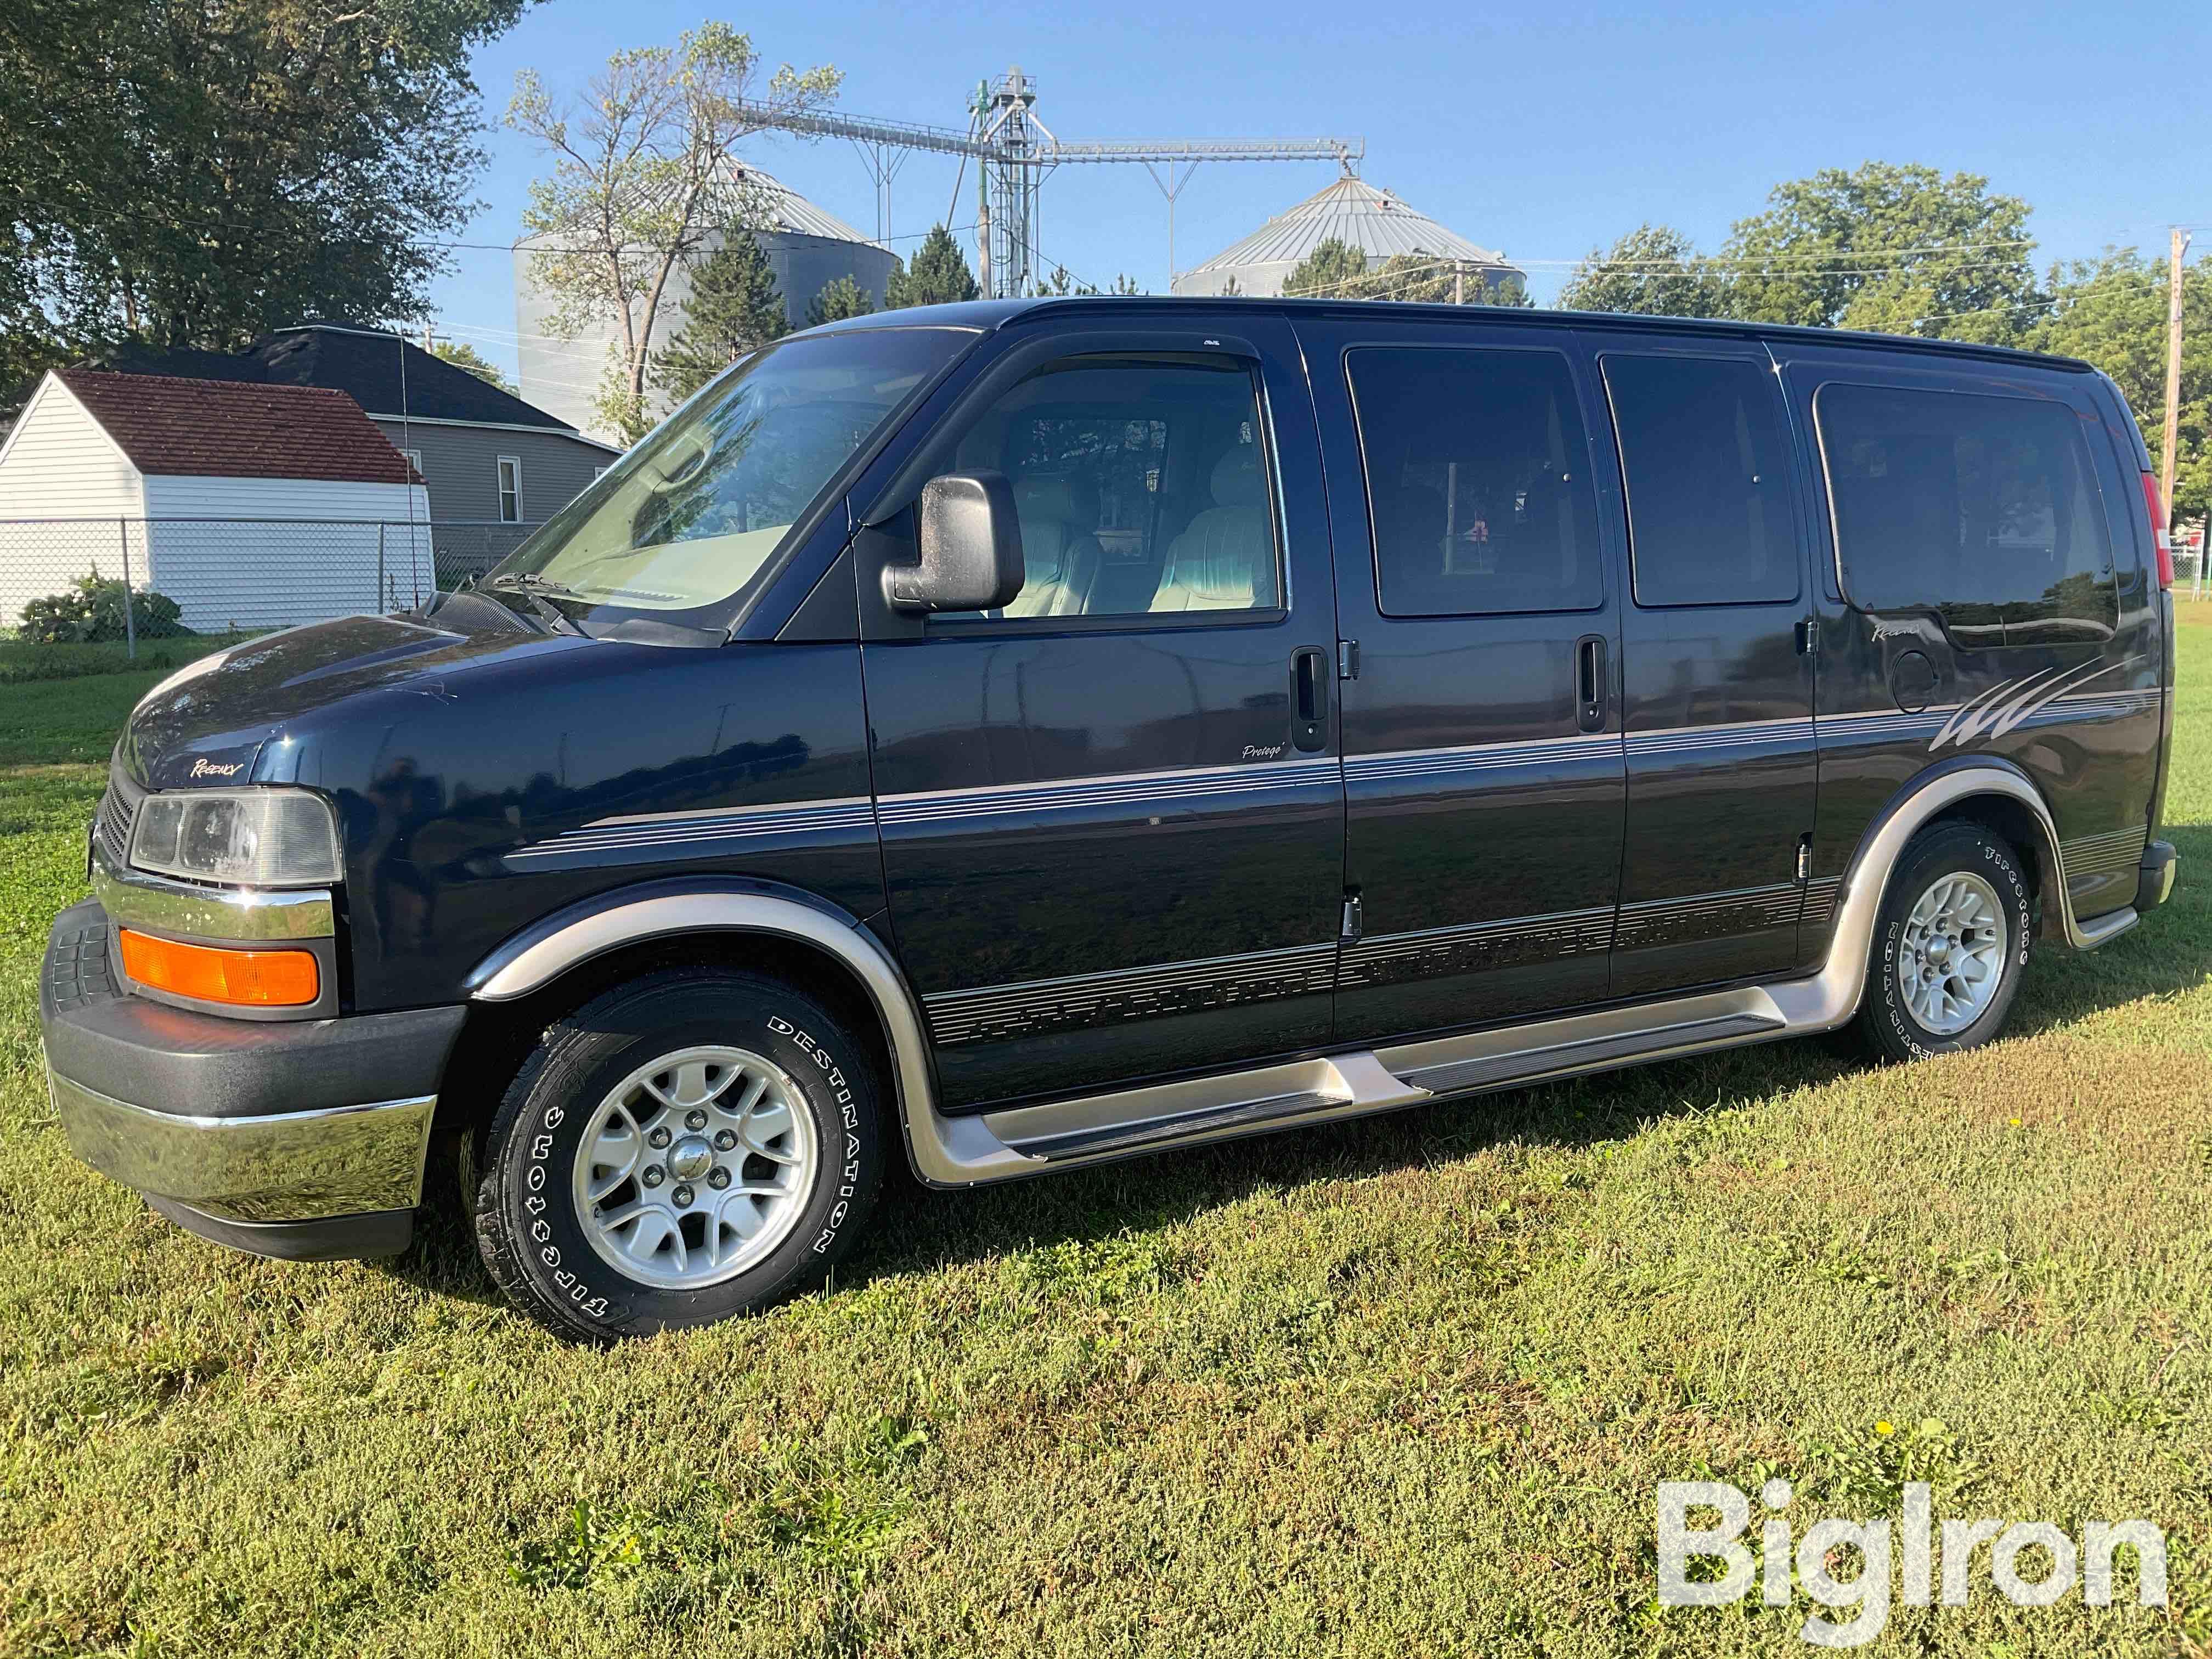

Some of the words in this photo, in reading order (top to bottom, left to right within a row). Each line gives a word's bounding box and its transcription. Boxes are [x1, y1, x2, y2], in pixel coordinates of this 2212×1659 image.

[1883, 922, 1948, 1061] ESTINATION
[525, 1106, 608, 1317] Firestone
[767, 1015, 860, 1254] DESTINATION
